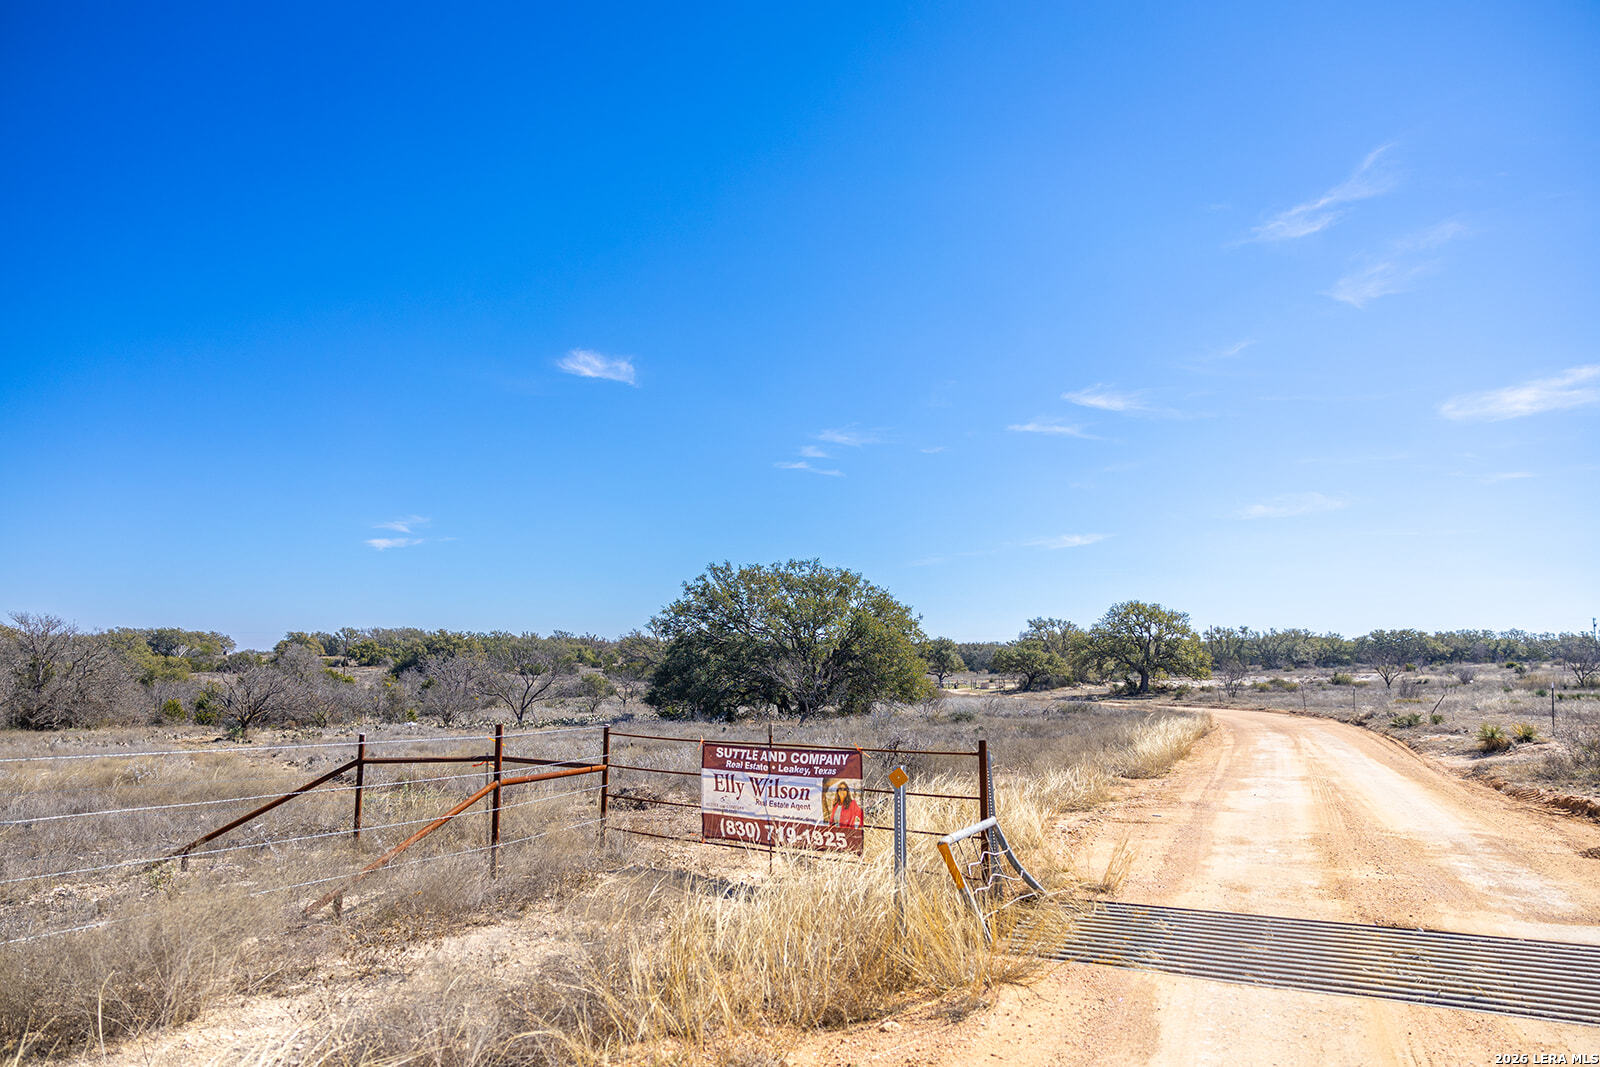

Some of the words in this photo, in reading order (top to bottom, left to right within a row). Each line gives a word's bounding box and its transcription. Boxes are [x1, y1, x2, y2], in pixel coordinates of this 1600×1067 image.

[716, 747, 758, 760] SUTTLE
[760, 750, 786, 762] AND
[790, 752, 849, 765] COMPANY
[725, 760, 743, 769] Real
[745, 761, 769, 771] Estate
[778, 764, 811, 776] Leakey,
[813, 766, 837, 775] Texas
[713, 773, 745, 800] Elly
[749, 776, 810, 800] Wilson
[769, 800, 789, 808] Estate
[790, 802, 811, 811] Agent
[720, 818, 760, 841] (830)
[764, 824, 848, 848] 719-1925
